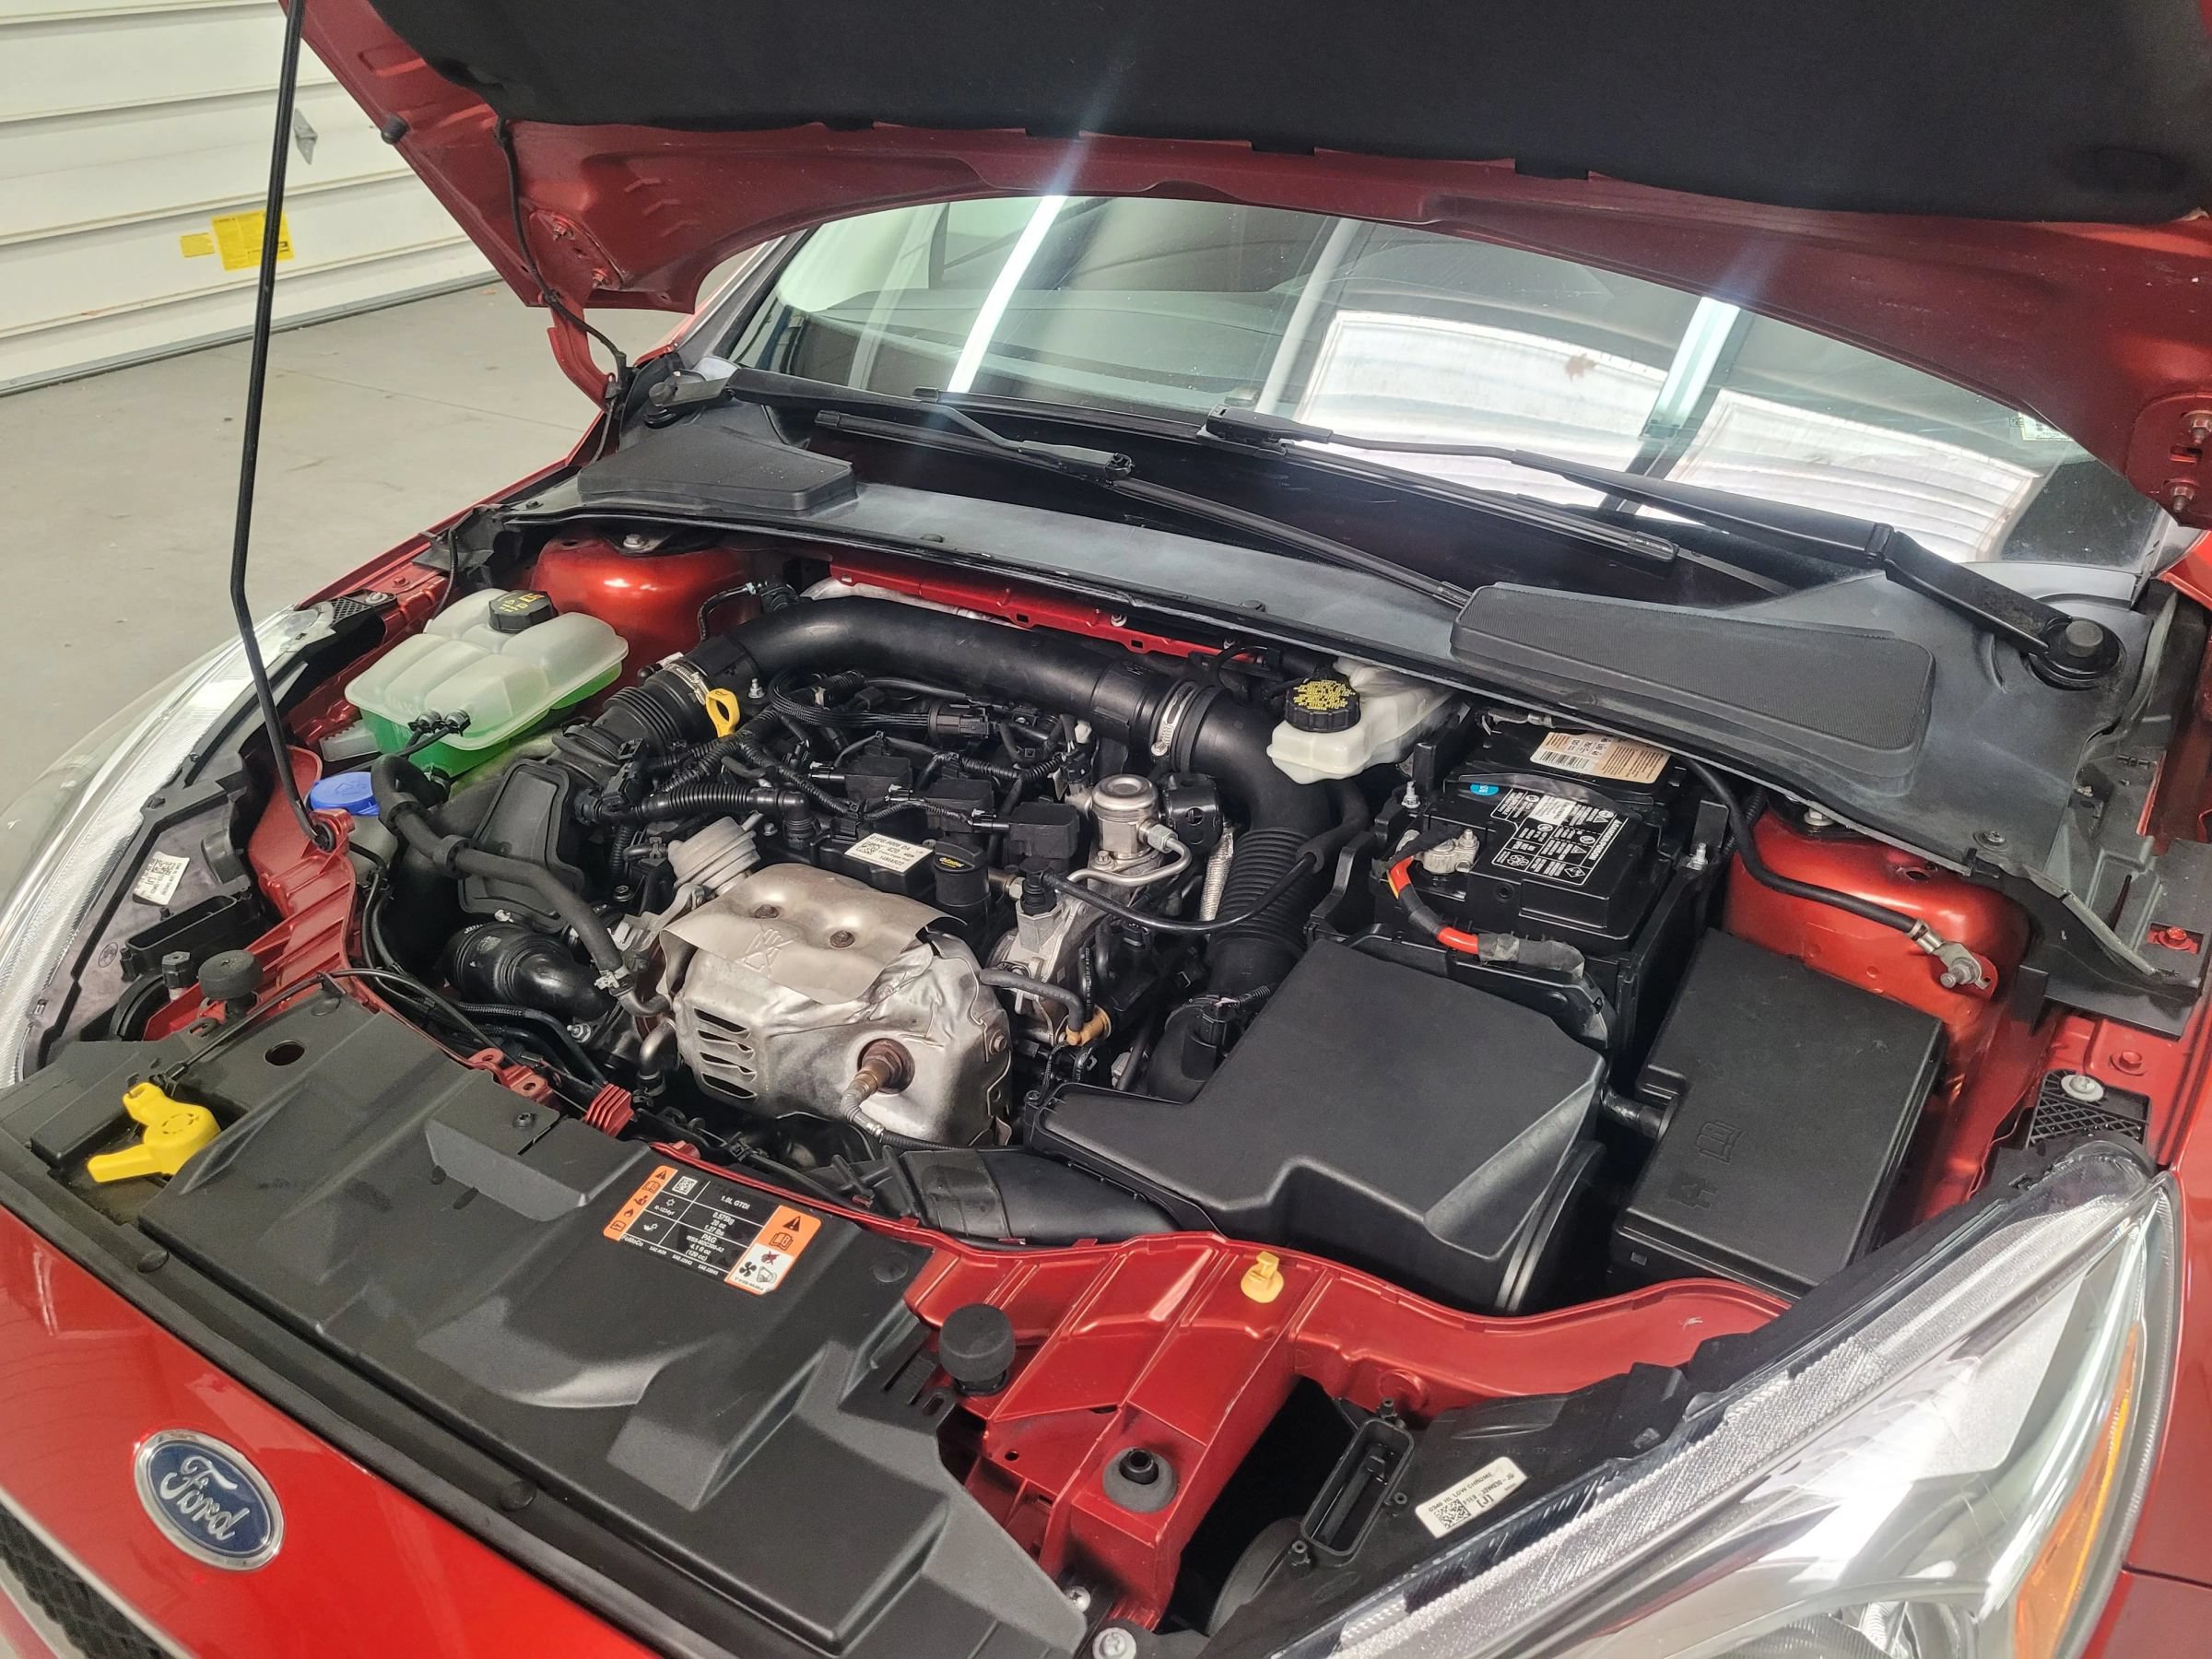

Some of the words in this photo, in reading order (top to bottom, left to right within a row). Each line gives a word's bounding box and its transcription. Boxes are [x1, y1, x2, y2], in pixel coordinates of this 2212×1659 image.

[721, 1195, 733, 1204] 1.0L
[734, 1199, 750, 1209] GTDI
[712, 1212, 735, 1225] 0.575kg
[704, 1224, 716, 1233] 1.27
[714, 1228, 724, 1236] lbs
[620, 1235, 643, 1246] FoMoCo
[701, 1234, 717, 1242] PAG
[686, 1249, 698, 1257] (120
[697, 1253, 707, 1262] cc)
[1453, 1487, 1467, 1498] LOW
[1467, 1472, 1493, 1489] CHROME
[159, 1454, 251, 1541] Ford
[1476, 1494, 1495, 1509] [J]
